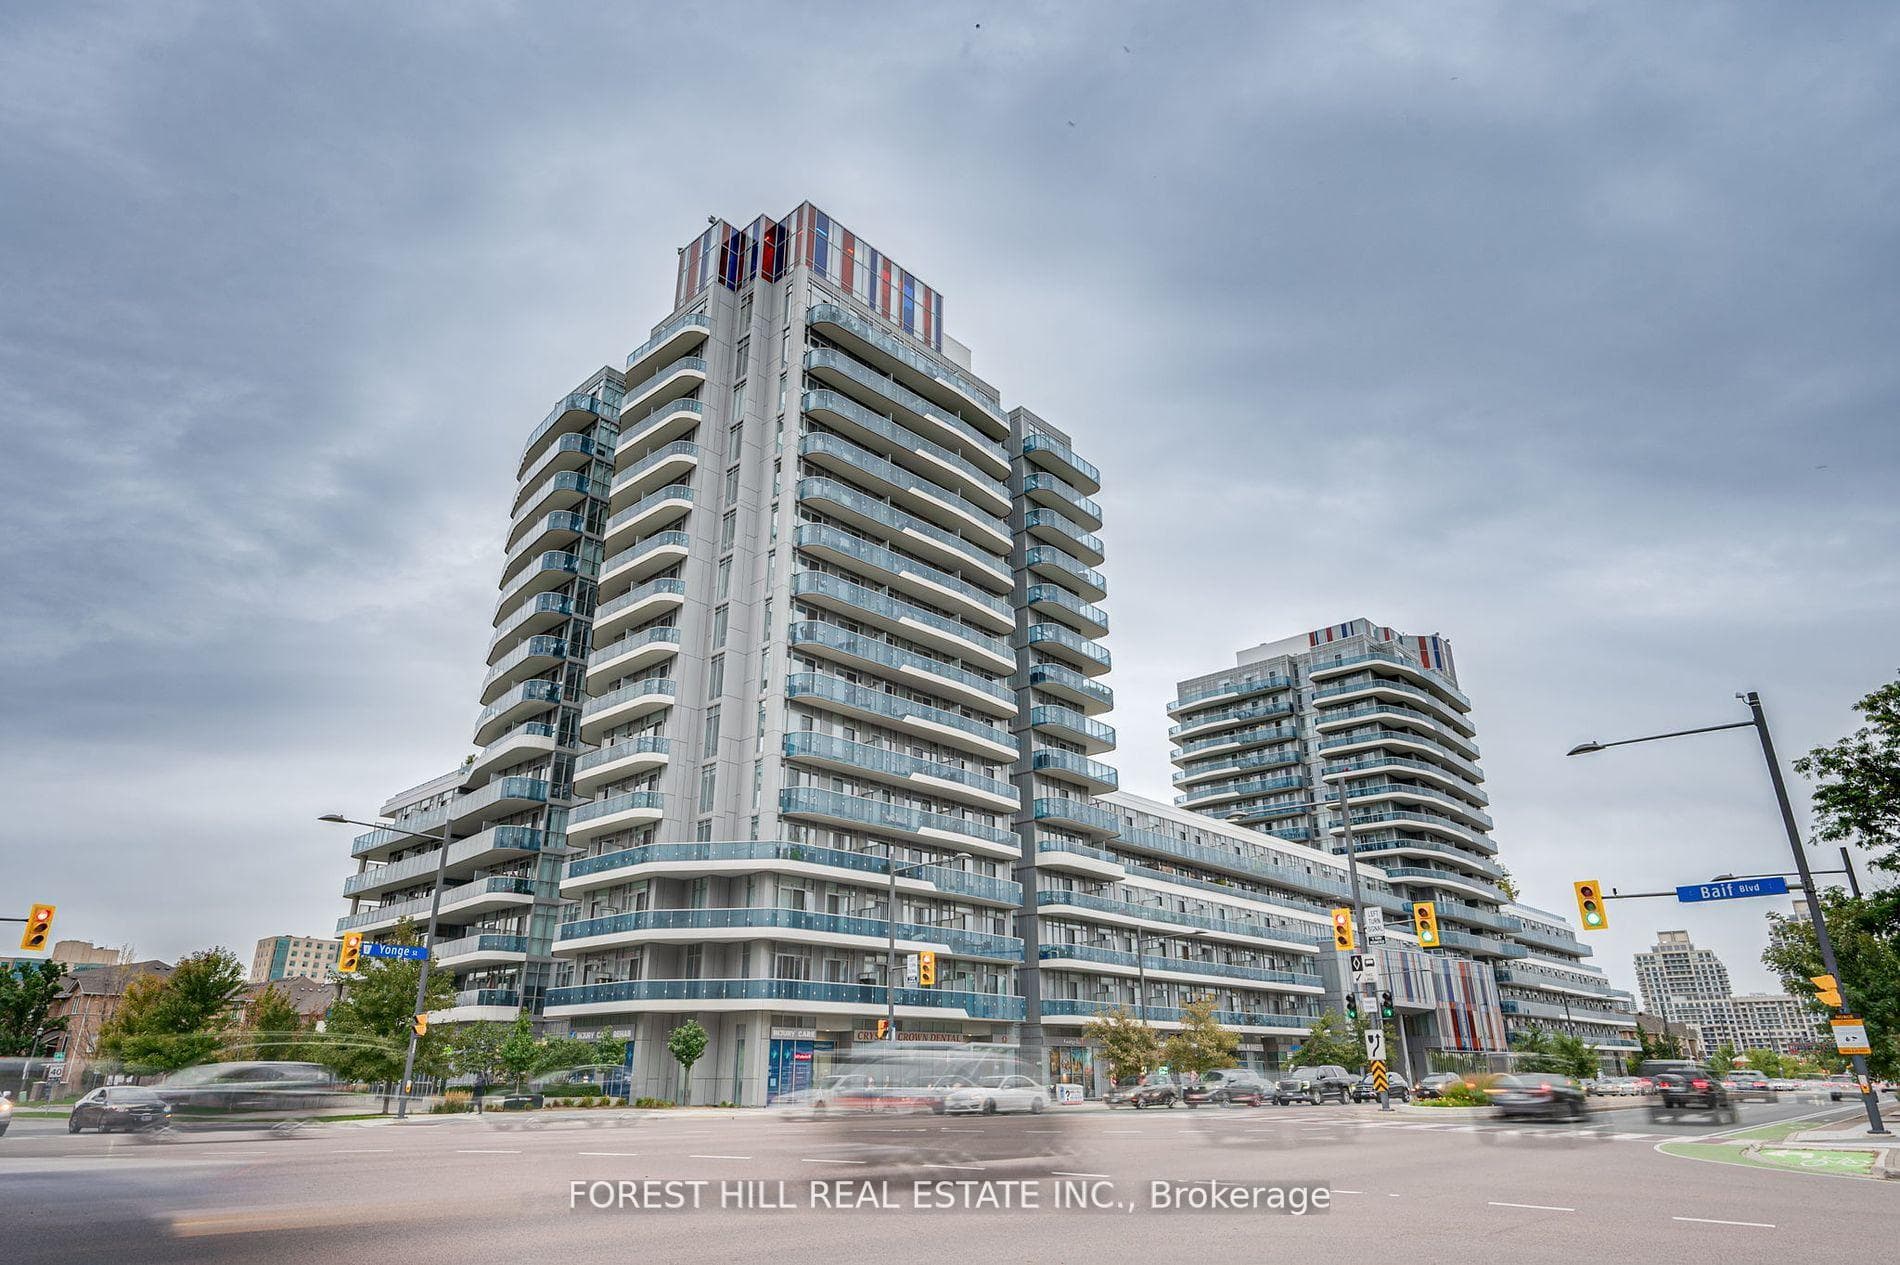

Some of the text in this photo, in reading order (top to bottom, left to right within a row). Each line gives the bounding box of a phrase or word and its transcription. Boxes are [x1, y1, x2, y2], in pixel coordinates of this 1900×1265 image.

[1700, 883, 1760, 899] Baif Blvd
[380, 943, 410, 958] Yonge
[898, 1033, 929, 1042] CROWN
[930, 1033, 960, 1042] DENTAL
[50, 1068, 62, 1076] 40
